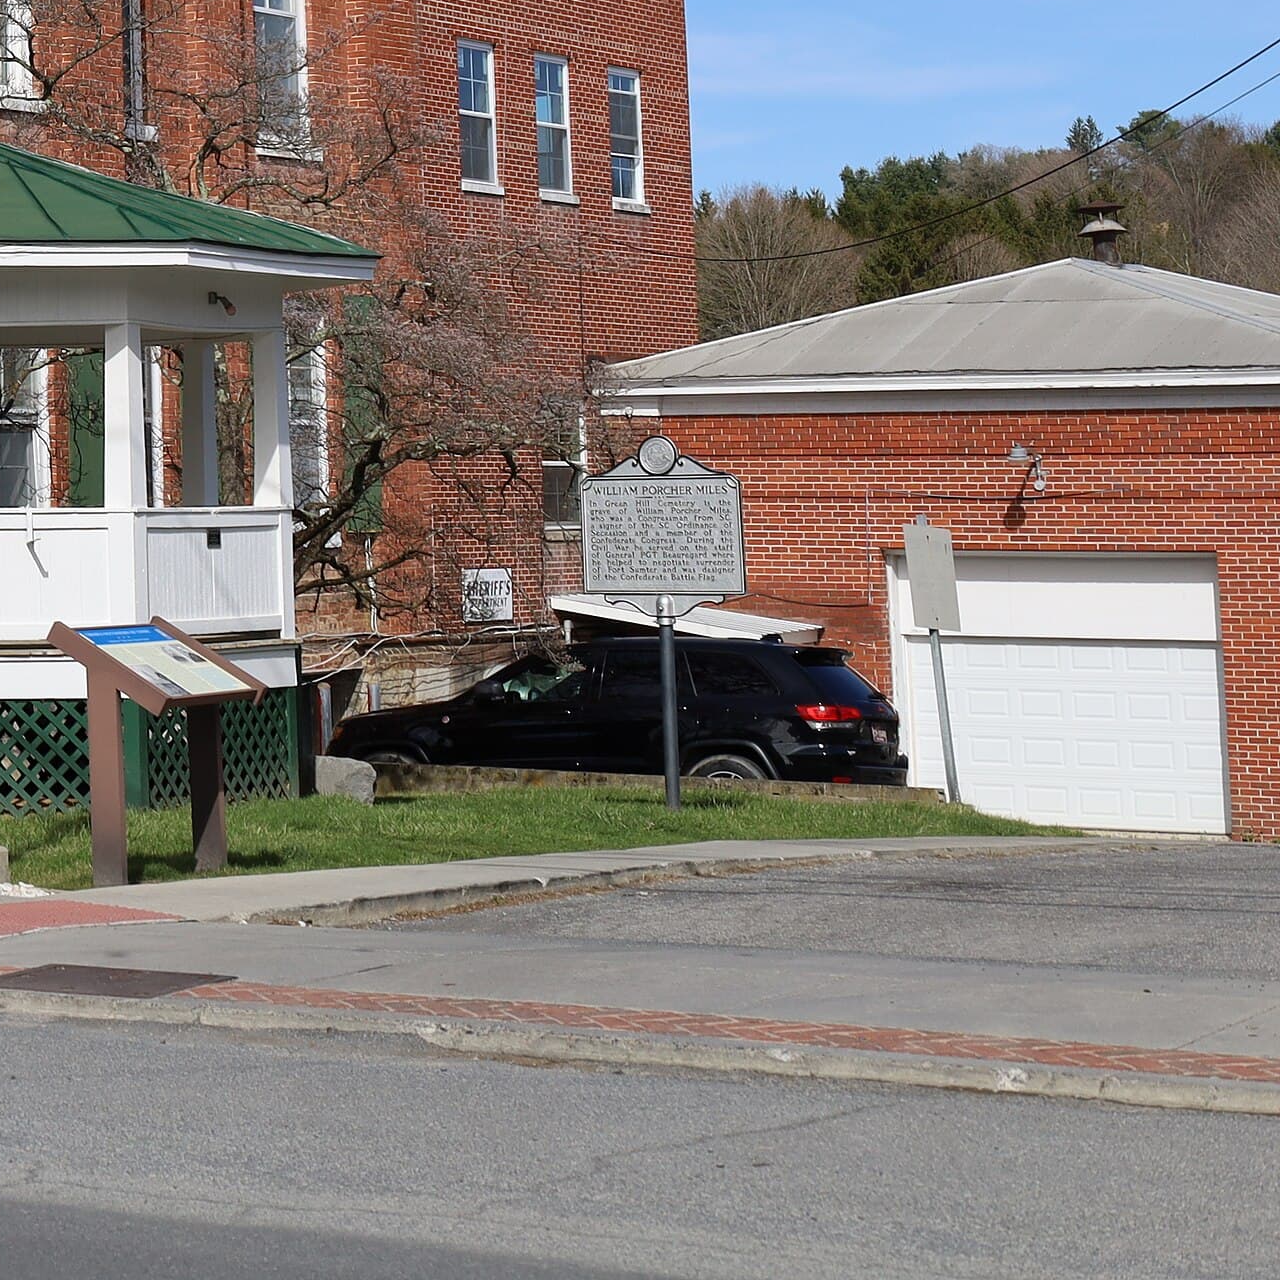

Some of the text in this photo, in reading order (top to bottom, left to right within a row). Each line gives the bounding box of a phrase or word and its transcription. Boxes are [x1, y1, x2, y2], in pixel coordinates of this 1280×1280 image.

[593, 485, 728, 496] WILLIAM PORCHER MILES
[658, 500, 696, 508] Cemetery
[590, 508, 611, 516] grave
[638, 514, 688, 522] Congressman
[686, 537, 715, 545] During
[662, 552, 707, 560] Beauregard
